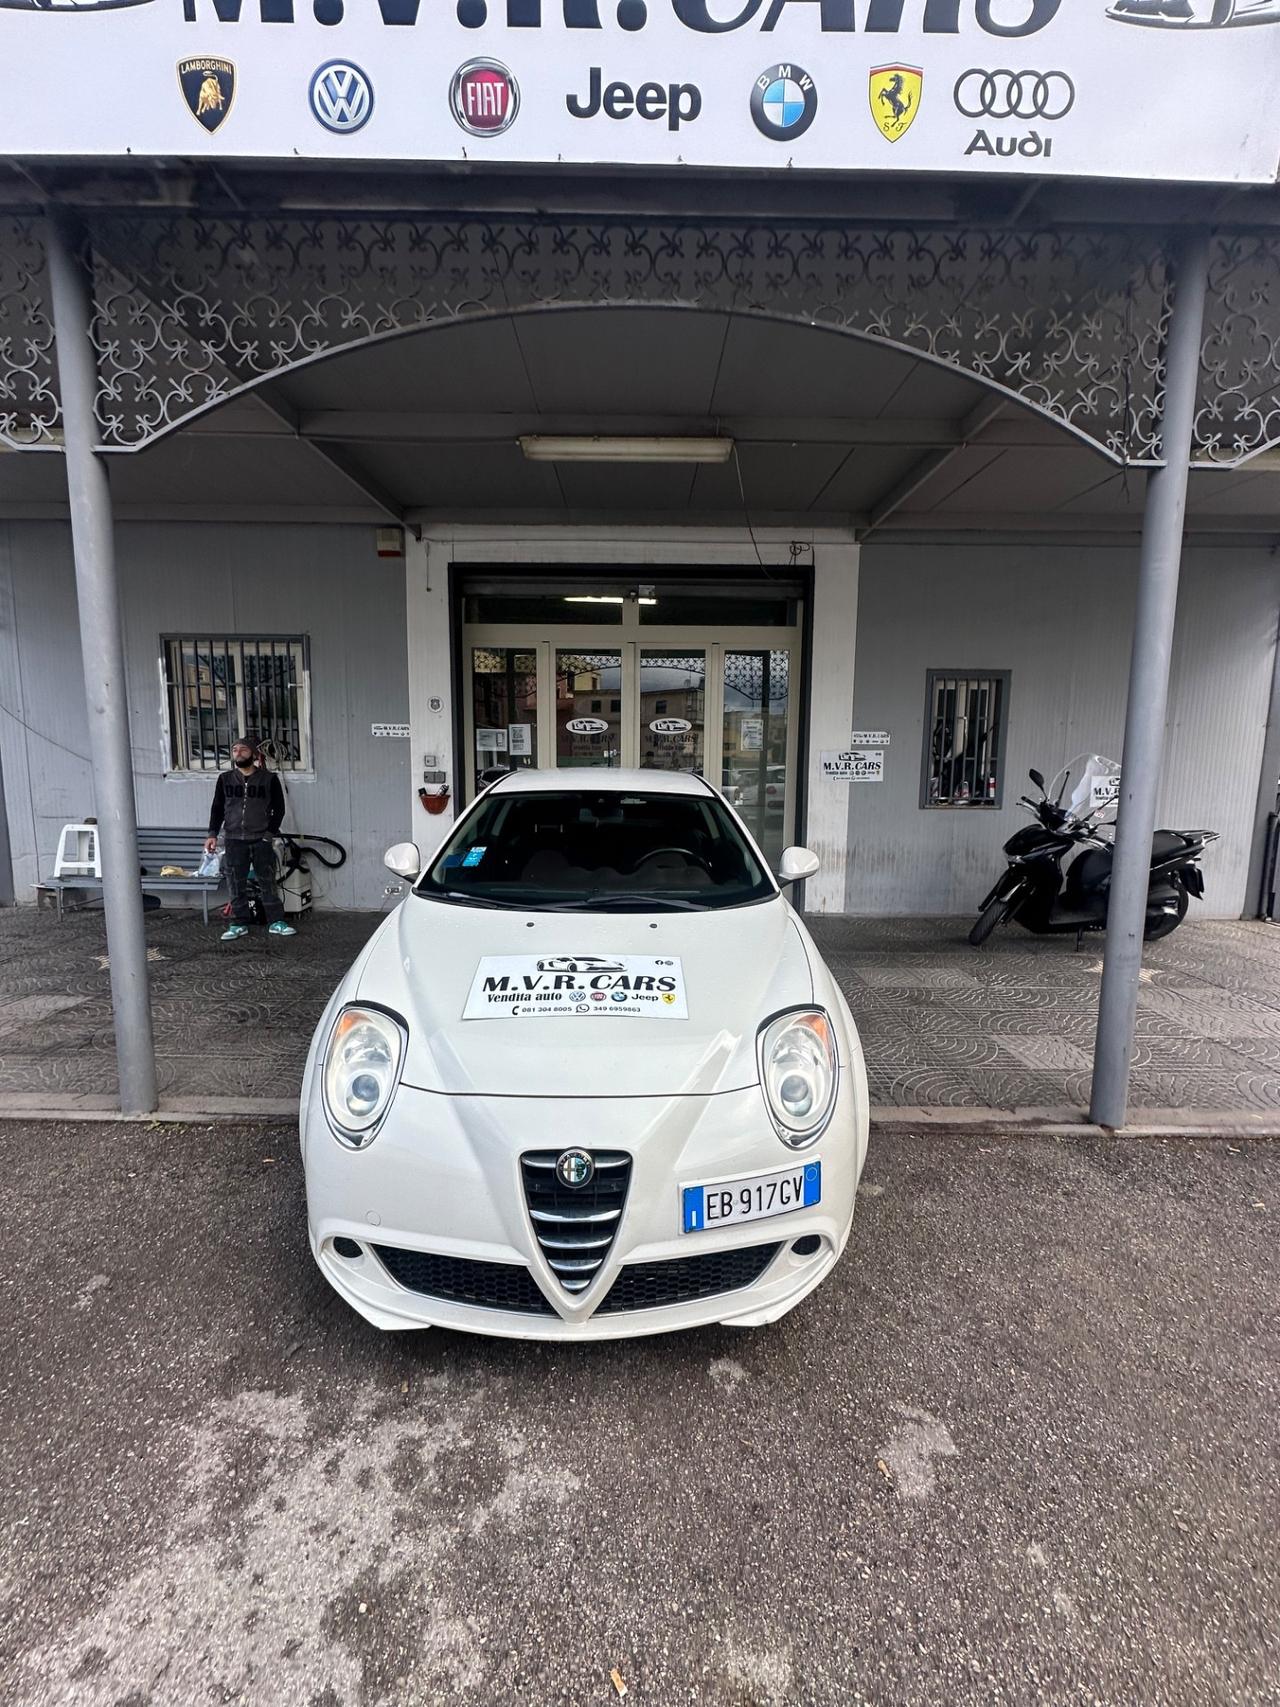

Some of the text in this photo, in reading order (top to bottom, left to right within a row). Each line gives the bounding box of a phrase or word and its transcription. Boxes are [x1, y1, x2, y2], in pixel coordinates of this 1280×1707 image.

[181, 60, 232, 75] LAMBORGHINI
[757, 65, 813, 91] BMW
[466, 82, 504, 116] FIAT
[566, 67, 702, 131] Jeep
[964, 129, 1052, 157] Audi
[487, 992, 562, 1003] Vendita auto
